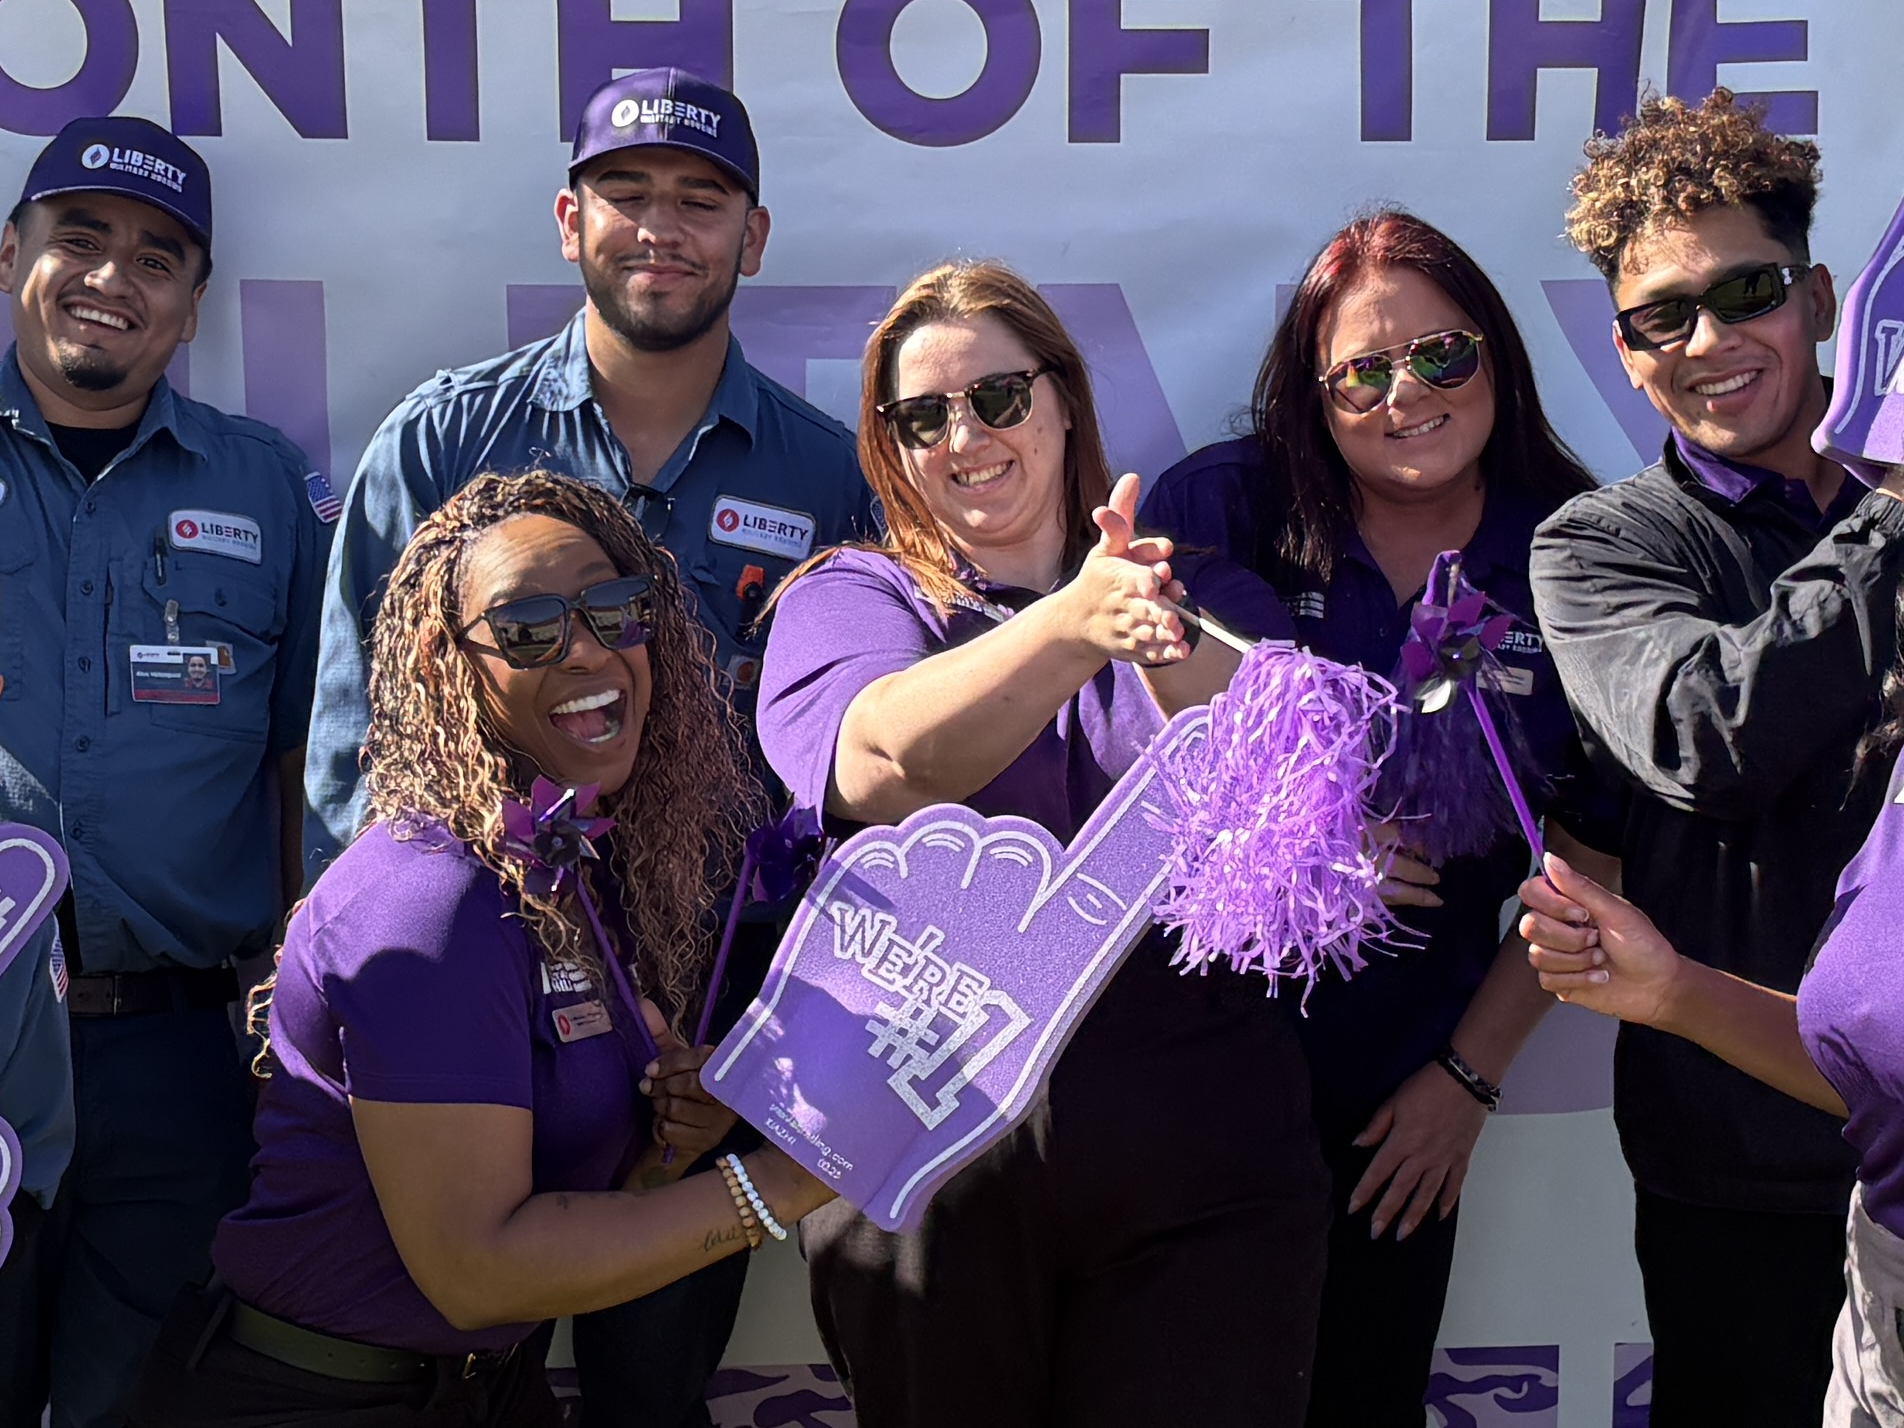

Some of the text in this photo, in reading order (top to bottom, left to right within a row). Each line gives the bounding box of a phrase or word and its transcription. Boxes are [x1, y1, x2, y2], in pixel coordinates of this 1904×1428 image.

[641, 99, 721, 128] LIBERTY
[111, 148, 187, 183] LIBERTY
[201, 522, 259, 544] LIBERTY
[743, 514, 809, 541] LIBERTY
[1500, 631, 1543, 651] ERTY
[830, 902, 992, 1025] WE'RE
[865, 990, 1034, 1131] #1
